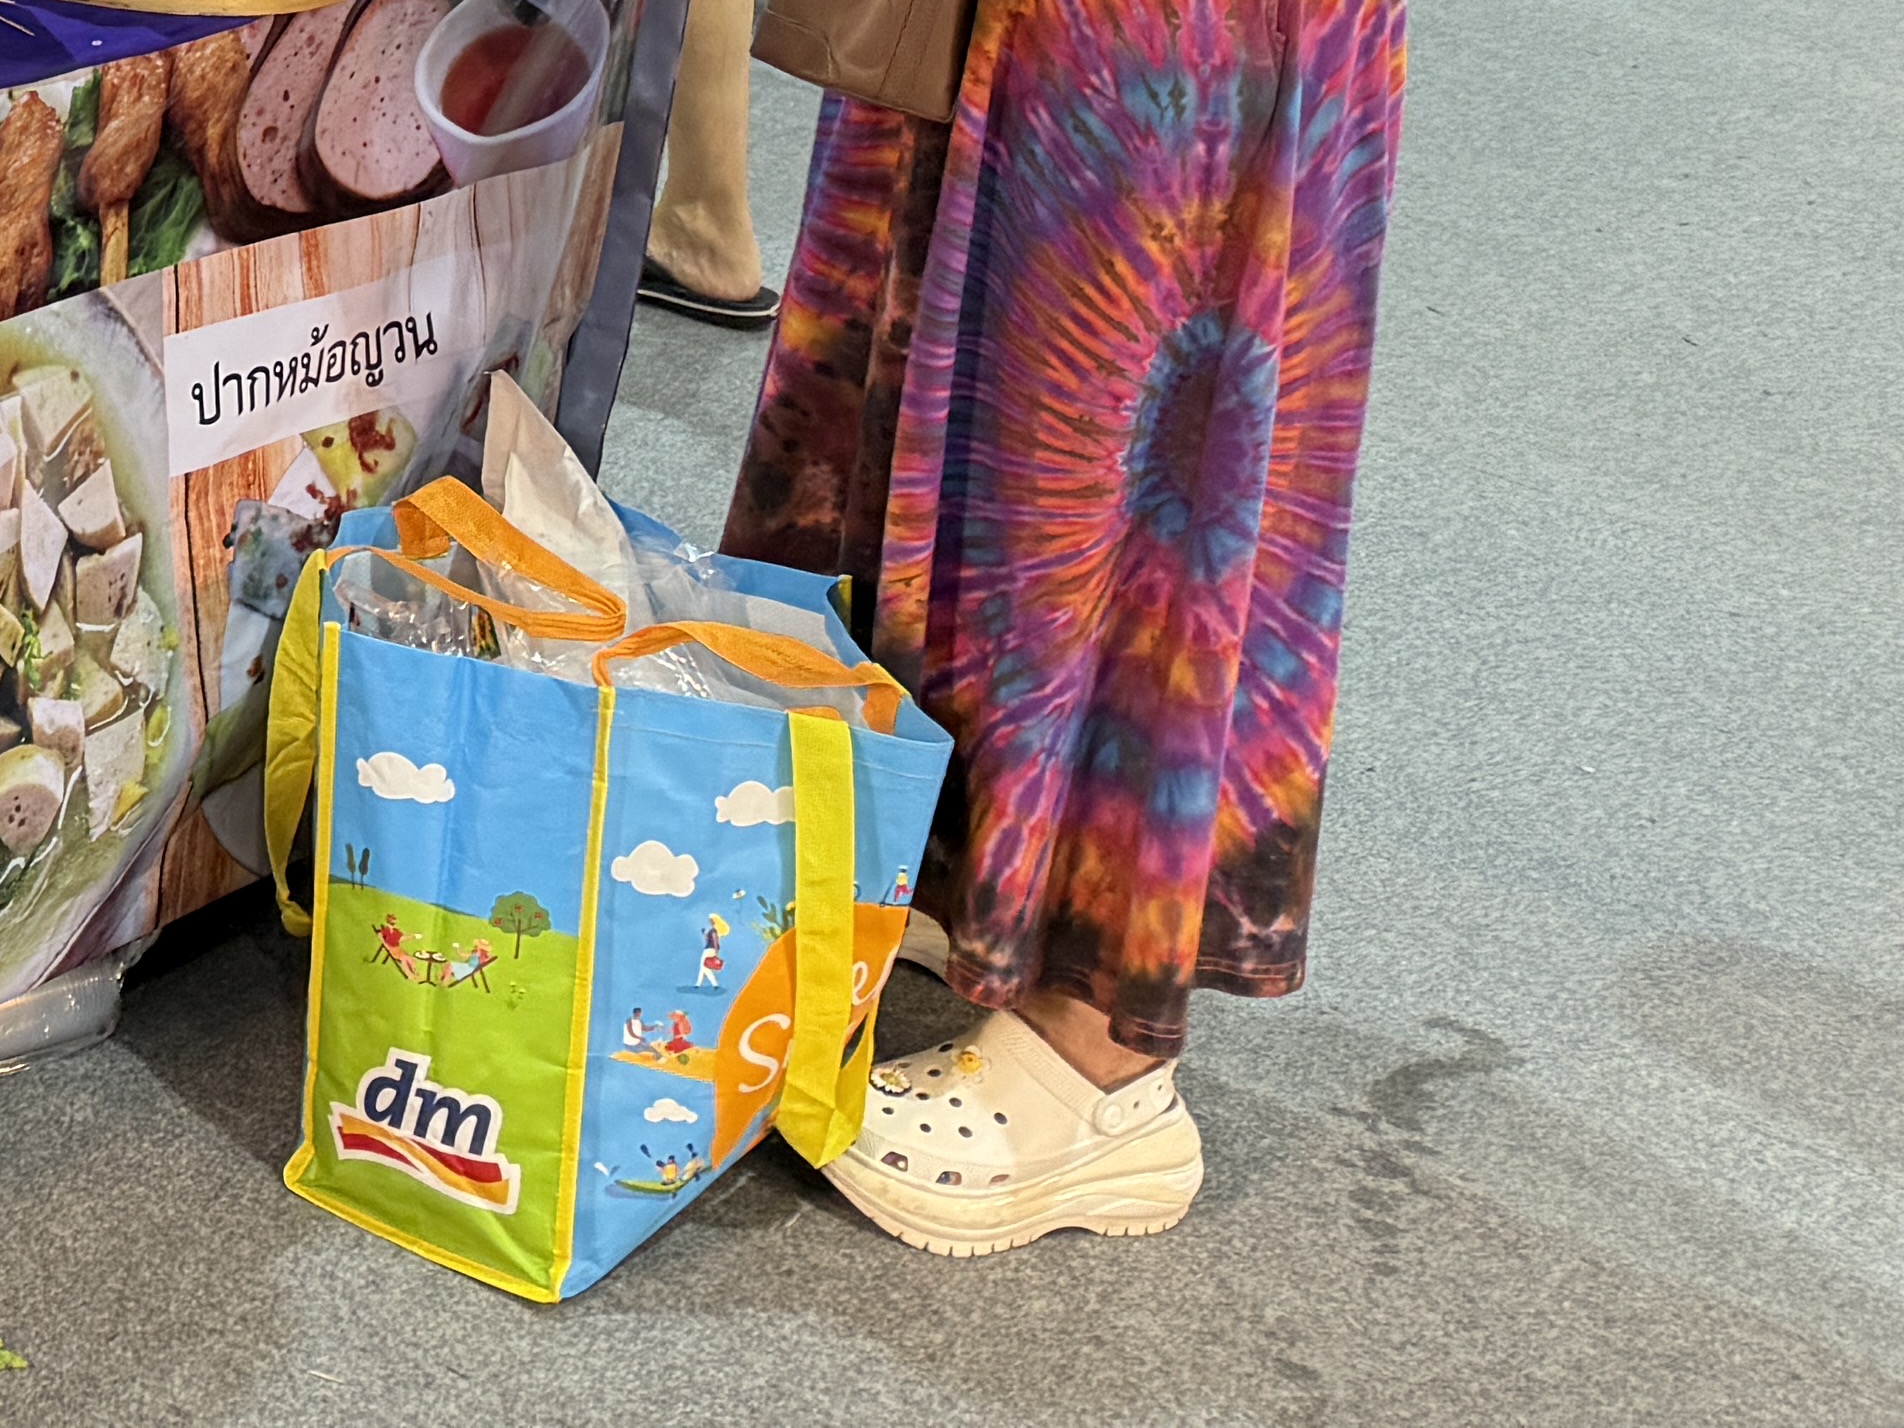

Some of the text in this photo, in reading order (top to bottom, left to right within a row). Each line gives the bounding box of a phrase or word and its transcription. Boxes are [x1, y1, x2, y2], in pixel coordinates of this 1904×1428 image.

[192, 312, 438, 425] ปากหม้อญวน
[364, 1058, 492, 1156] dm
